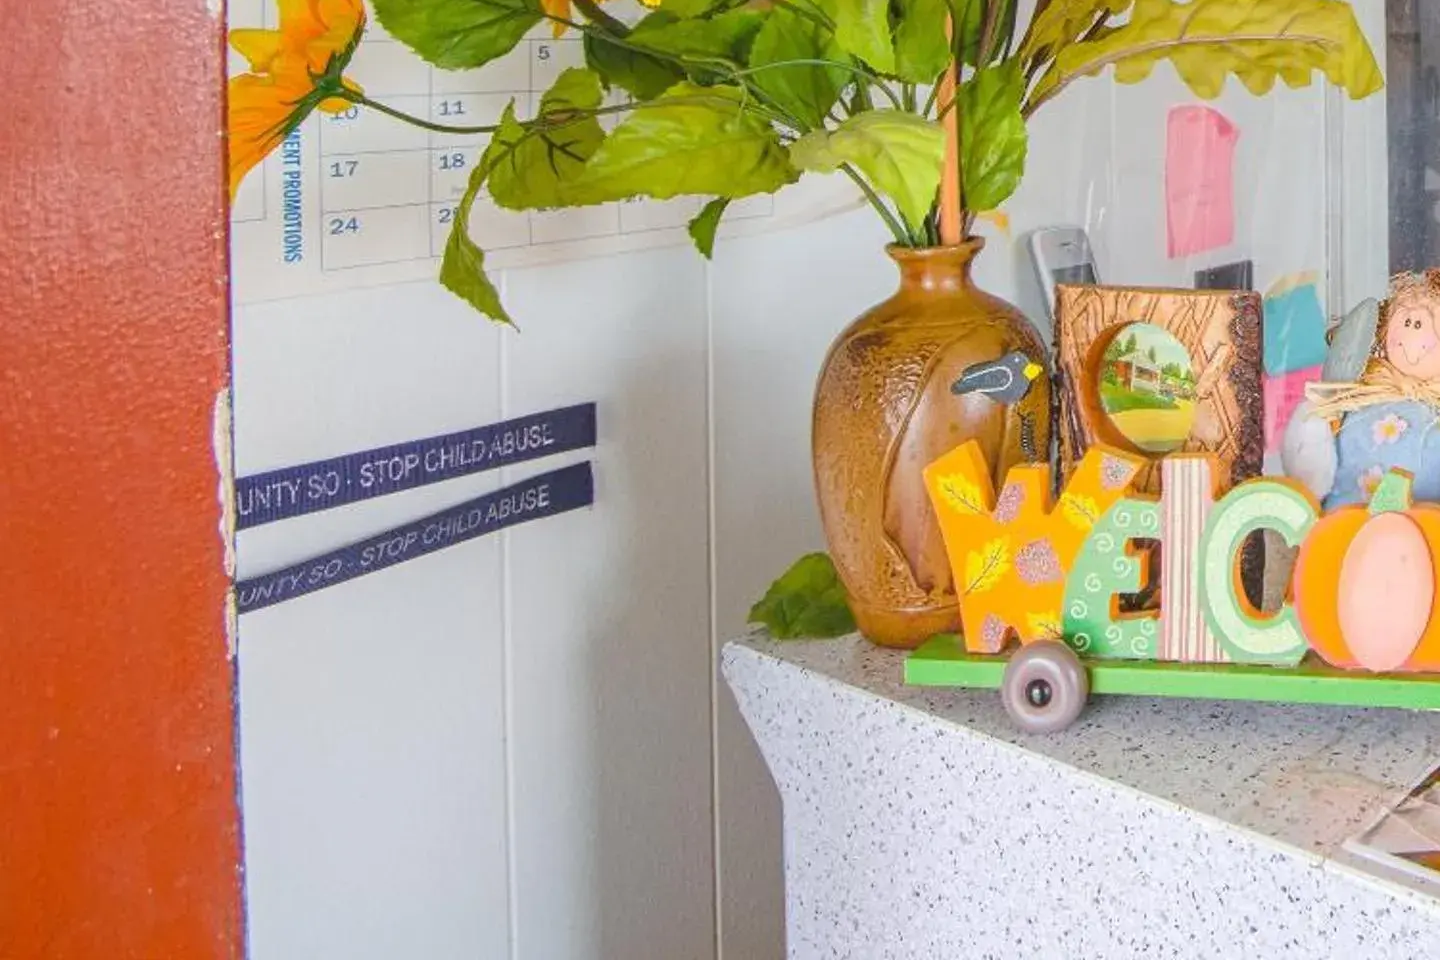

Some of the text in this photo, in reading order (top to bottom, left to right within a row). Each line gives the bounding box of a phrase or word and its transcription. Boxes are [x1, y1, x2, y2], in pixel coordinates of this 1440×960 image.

[538, 45, 550, 61] 5
[439, 100, 467, 117] 11
[284, 128, 304, 168] MENT
[331, 155, 466, 178] 17 18
[331, 216, 359, 234] 24
[236, 423, 556, 519] UNTY SO STOP CHILD ABUSE
[236, 483, 552, 606] UNTY SO STOP CHILD ABUSE
